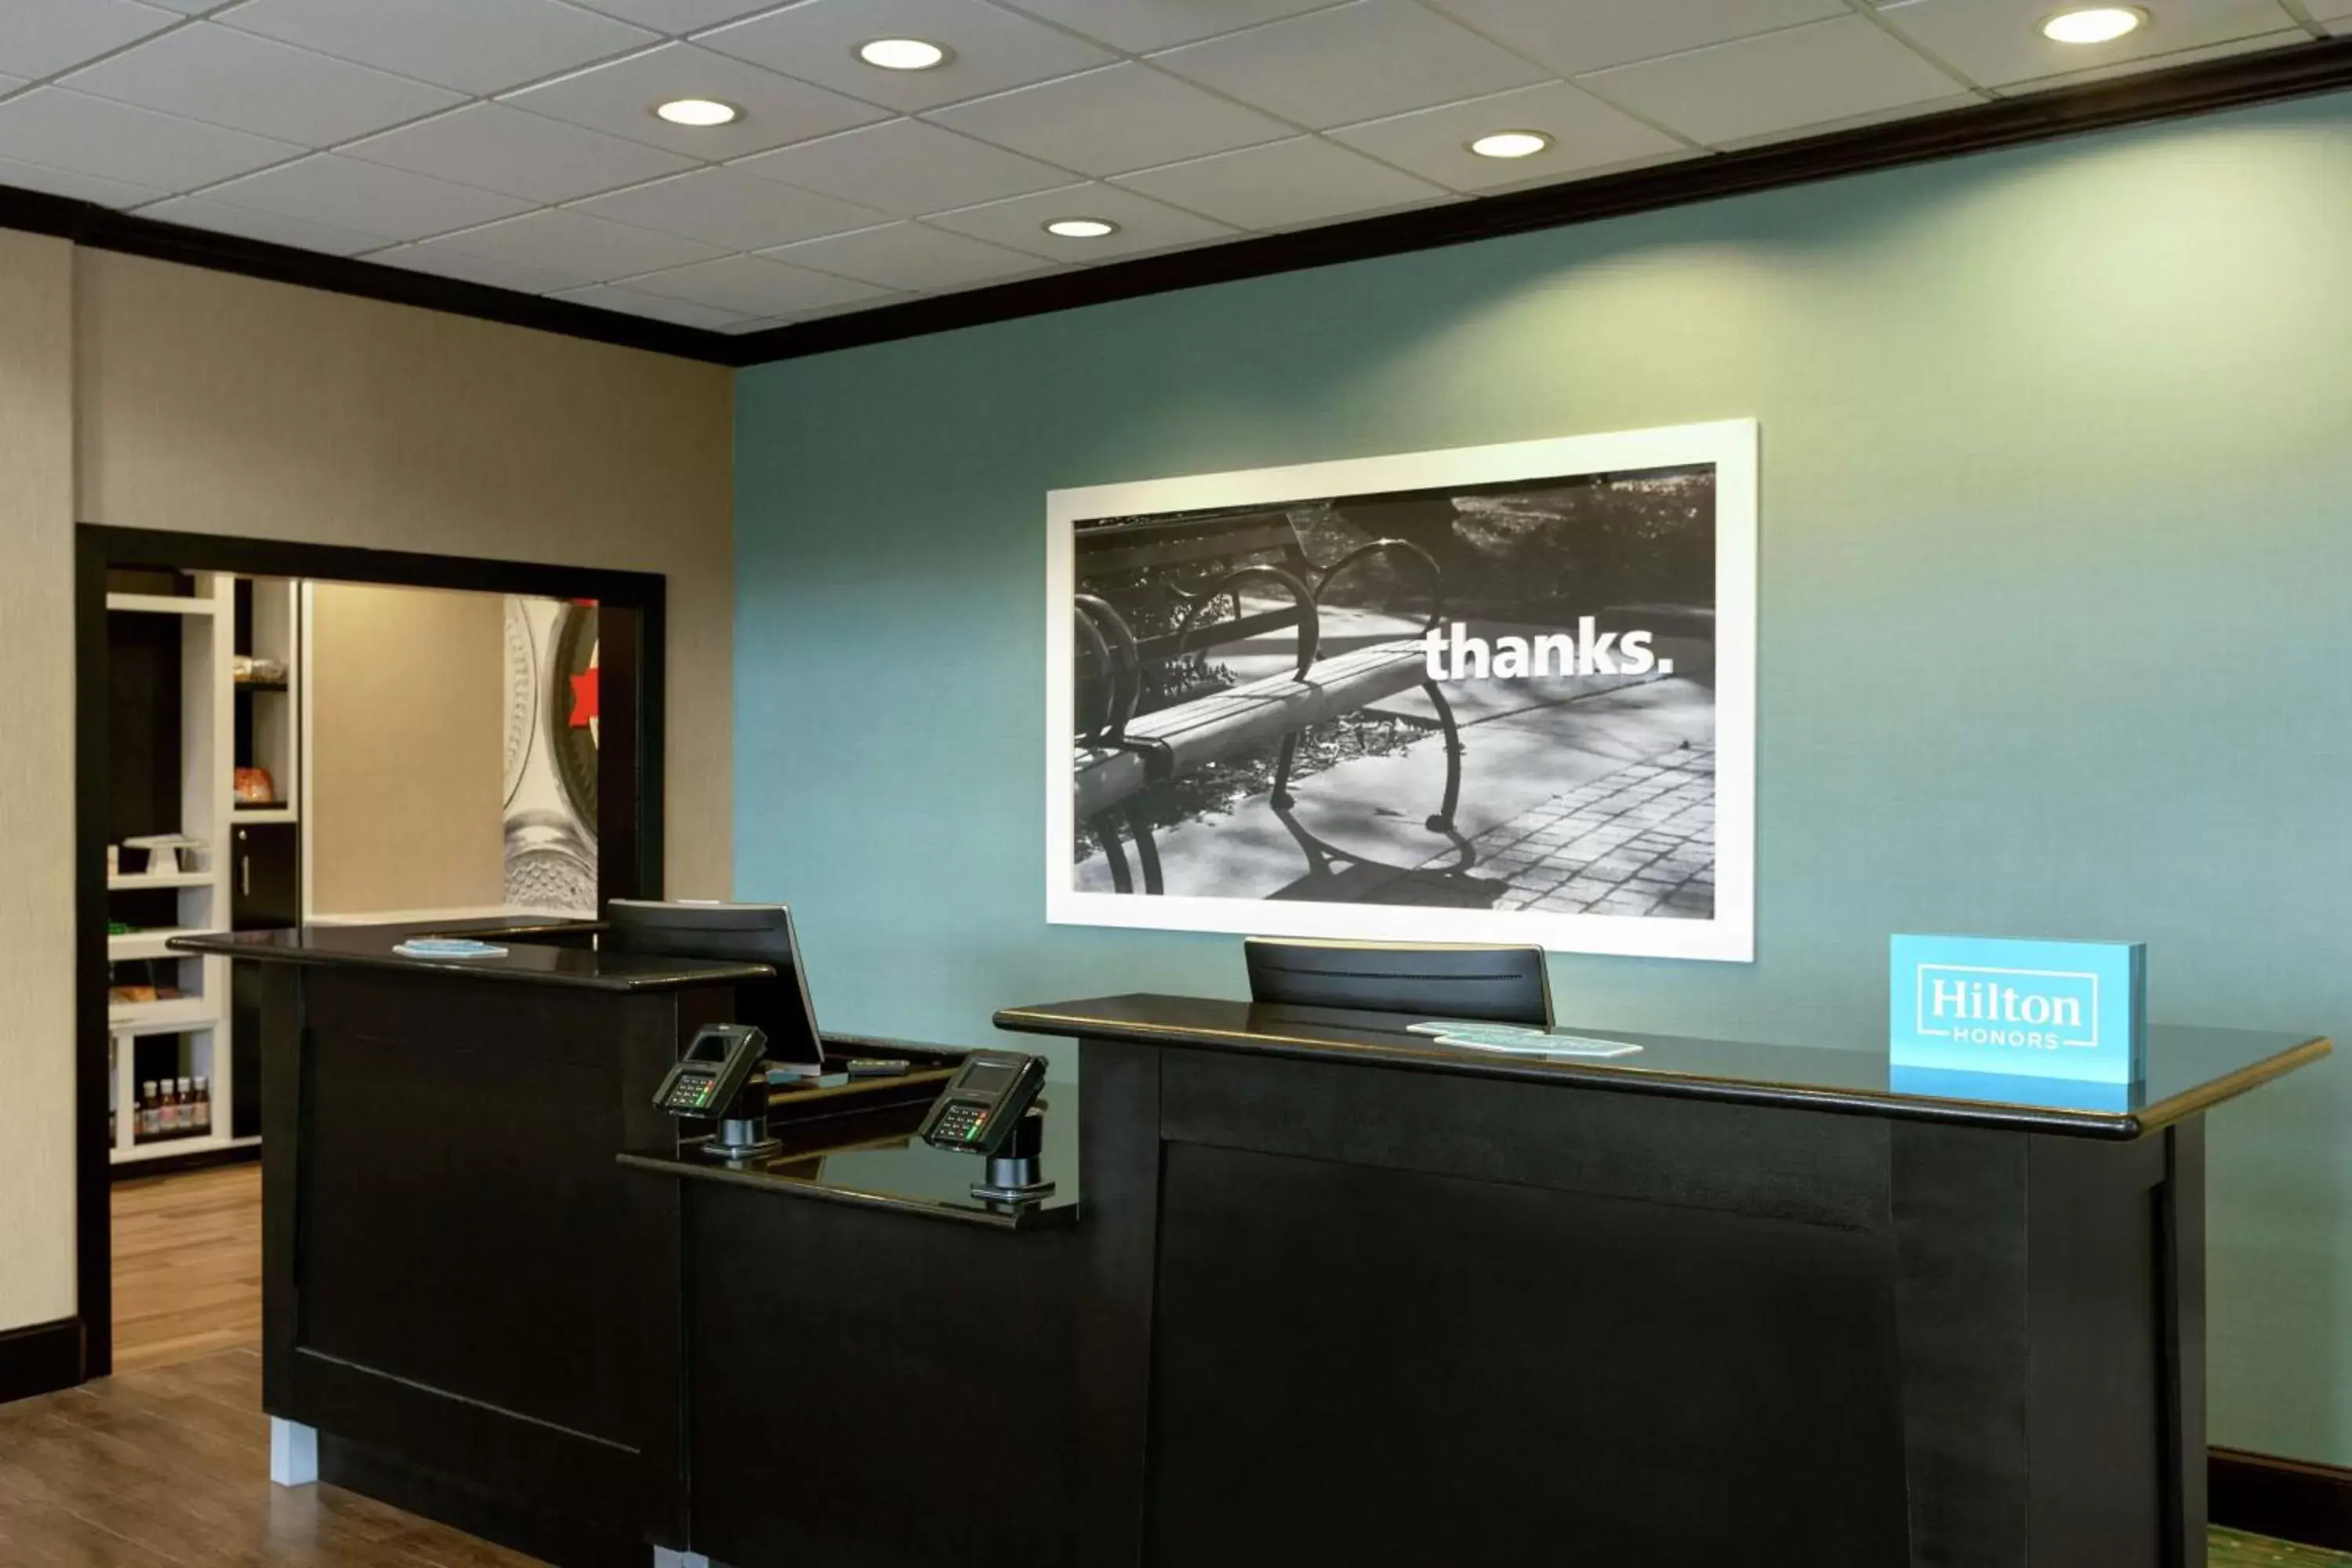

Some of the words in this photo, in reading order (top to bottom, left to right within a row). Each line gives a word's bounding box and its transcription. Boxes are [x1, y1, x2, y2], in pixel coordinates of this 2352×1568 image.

[1422, 616, 1674, 681] thanks.
[1933, 979, 2082, 1026] Hilton
[1953, 1027, 2059, 1050] HONORS
